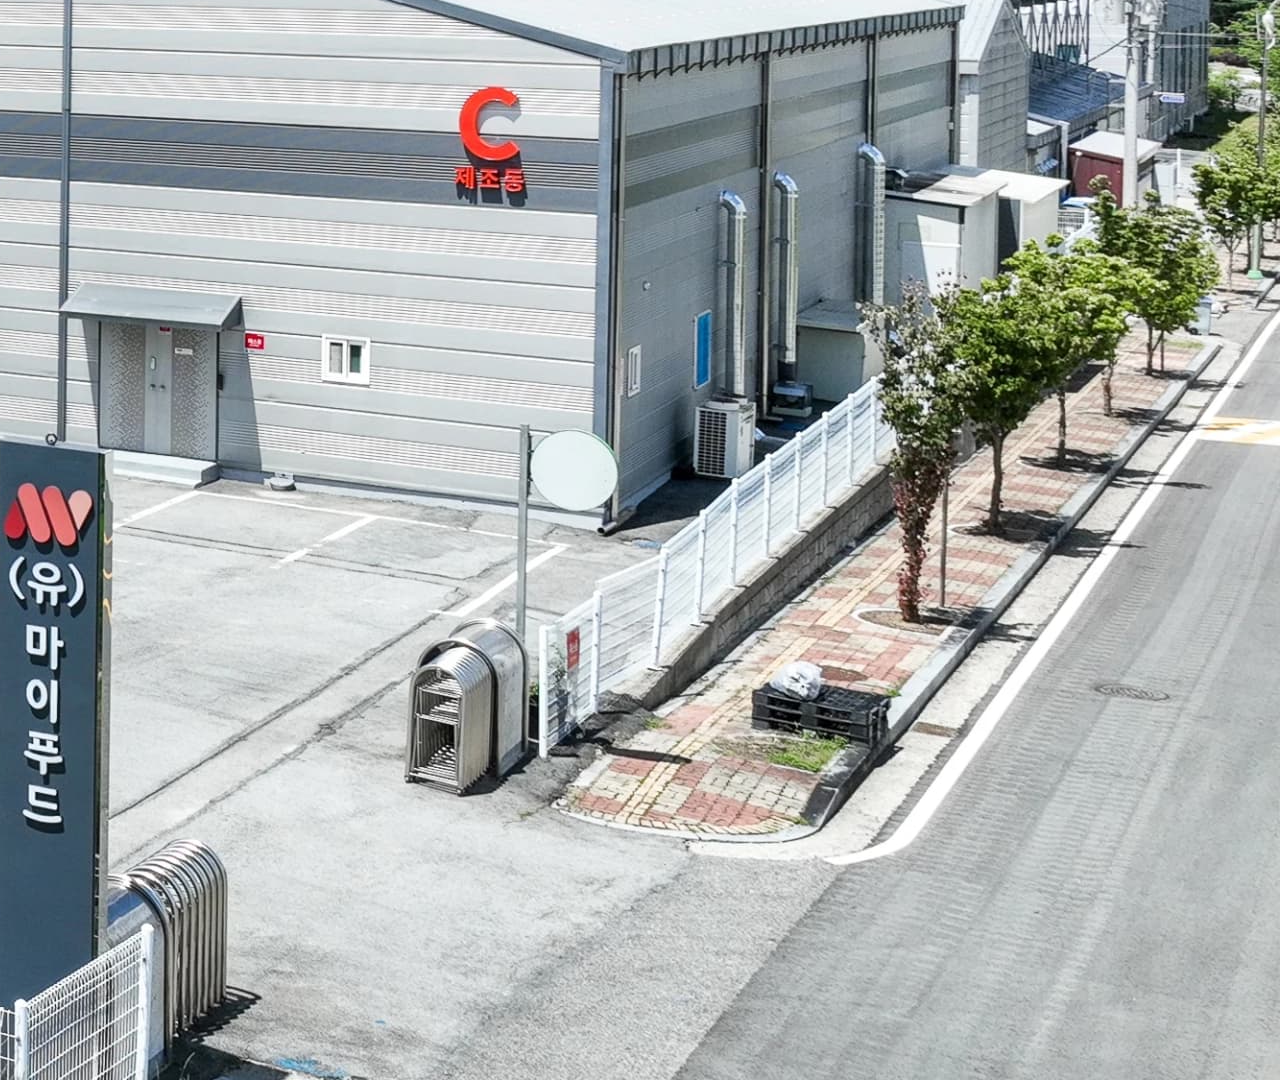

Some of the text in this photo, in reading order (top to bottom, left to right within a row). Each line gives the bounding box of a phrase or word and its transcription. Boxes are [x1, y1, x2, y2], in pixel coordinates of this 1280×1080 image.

[458, 86, 521, 161] C
[453, 166, 525, 193] 제조동
[8, 555, 85, 824] (유)마이푸드
